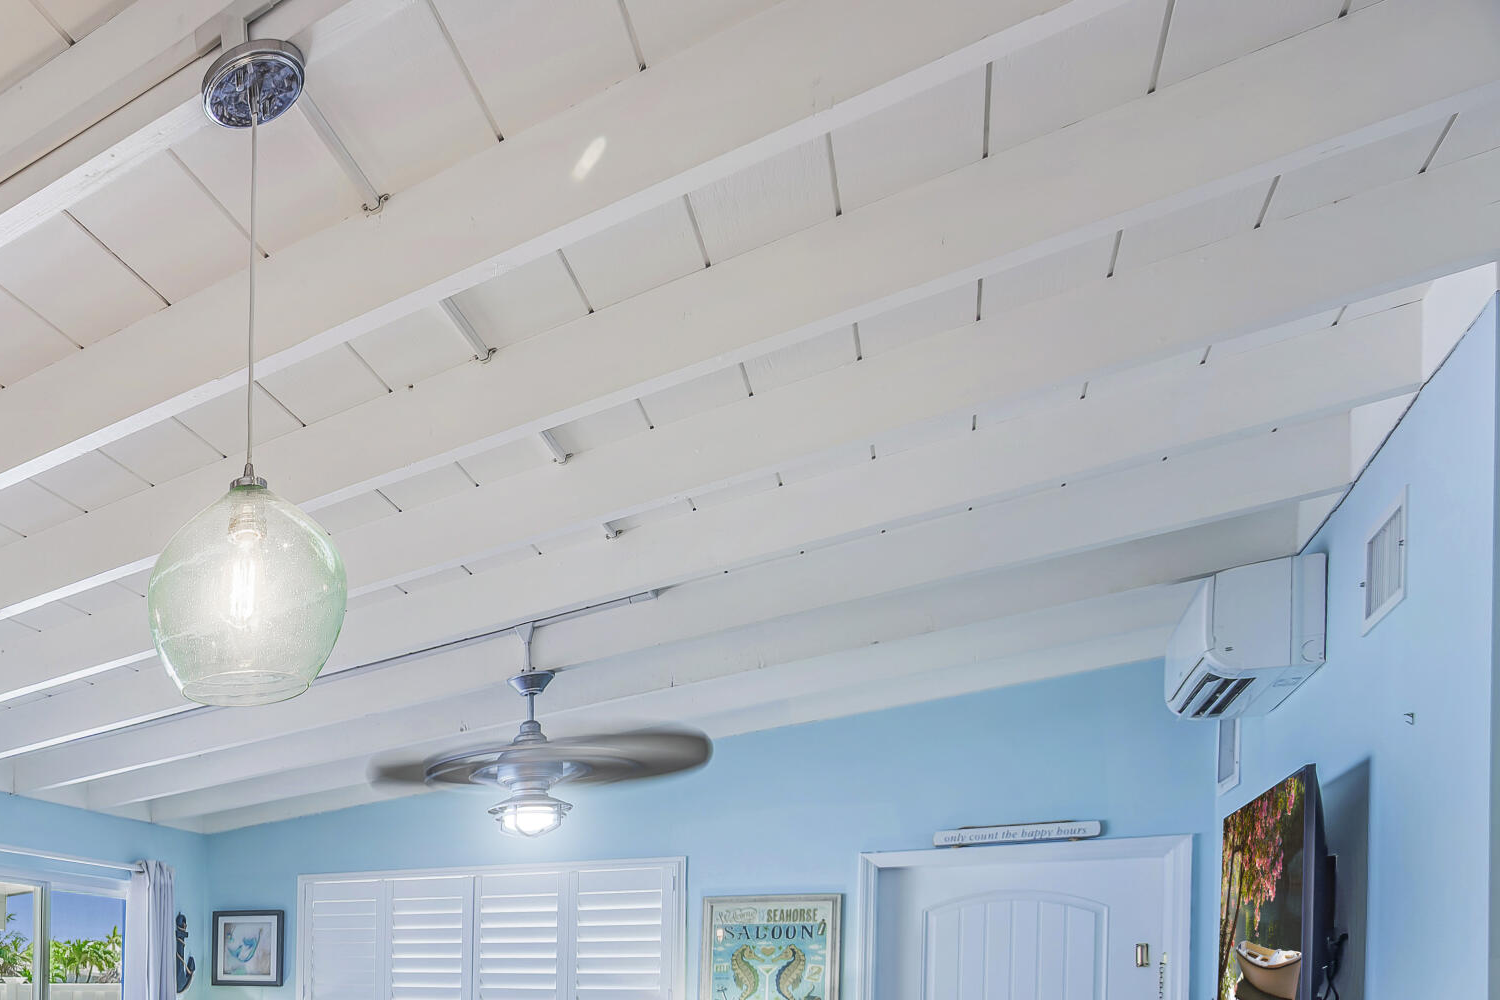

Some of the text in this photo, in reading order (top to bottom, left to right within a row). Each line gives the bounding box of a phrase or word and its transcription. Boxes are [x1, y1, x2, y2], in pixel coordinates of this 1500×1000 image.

[944, 826, 1087, 843] only count the happy hours
[766, 908, 819, 923] SEAHORSE
[724, 925, 814, 940] SALOON
